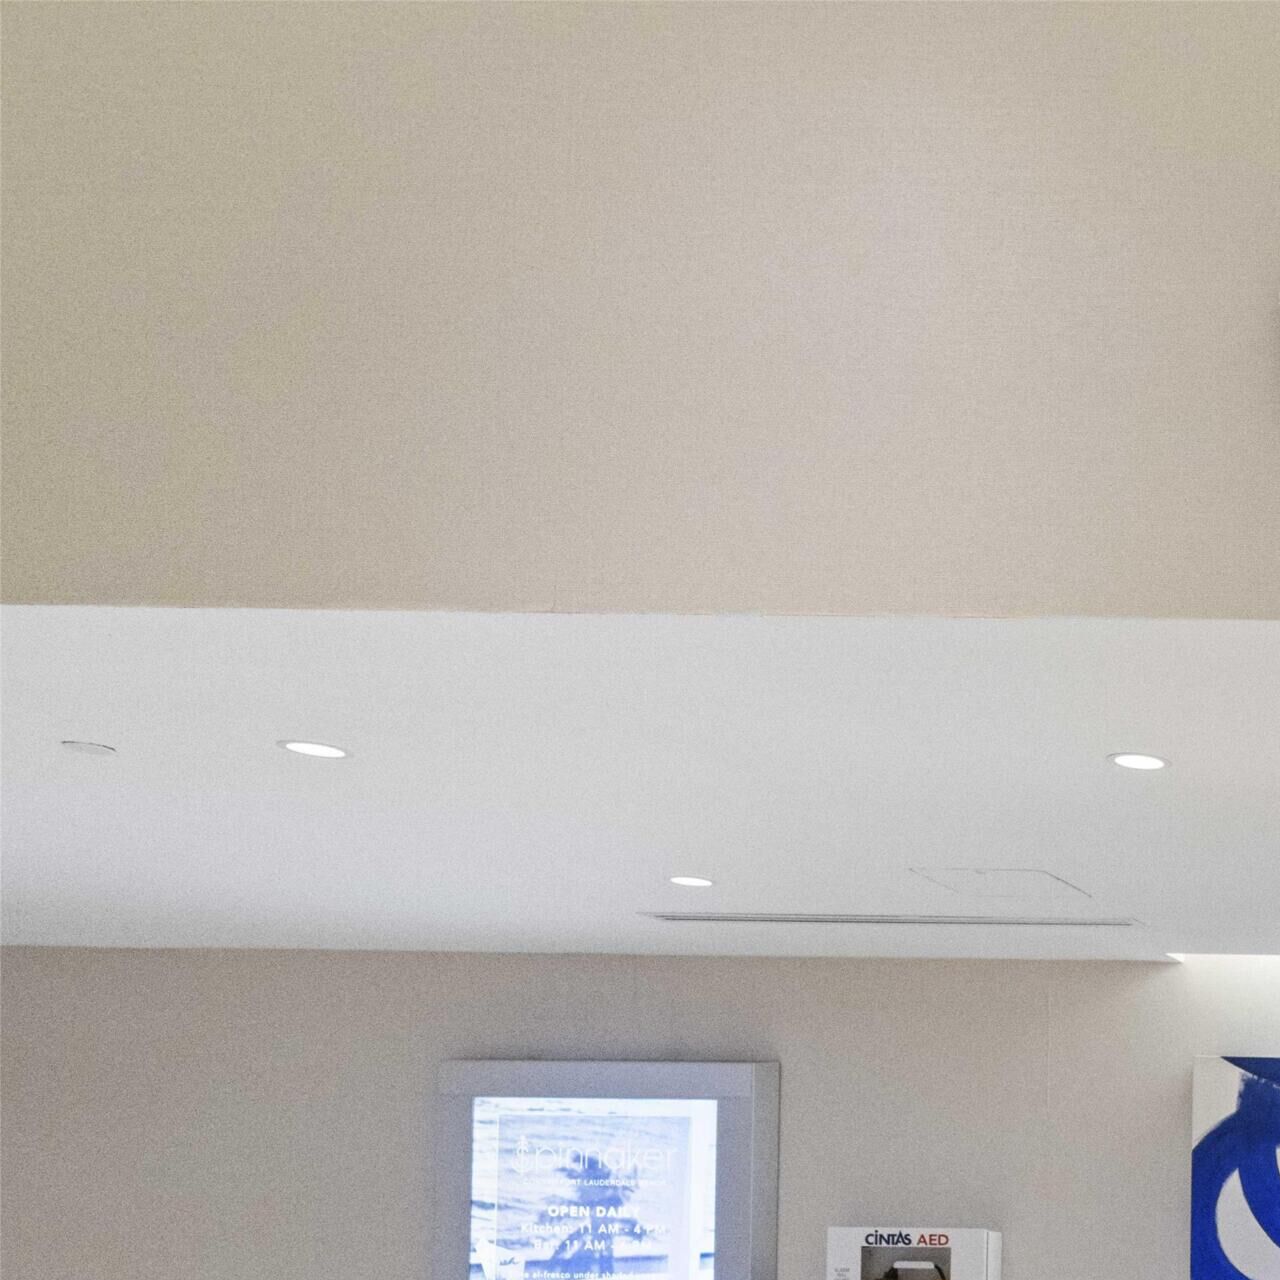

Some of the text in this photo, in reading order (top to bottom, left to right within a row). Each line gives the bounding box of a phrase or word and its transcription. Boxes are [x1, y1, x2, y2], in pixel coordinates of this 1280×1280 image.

[548, 1205, 590, 1217] OPEN
[578, 1223, 592, 1234] 11
[598, 1223, 619, 1234] AM
[634, 1223, 641, 1234] 4
[584, 1240, 606, 1250] AM
[917, 1234, 949, 1246] AED
